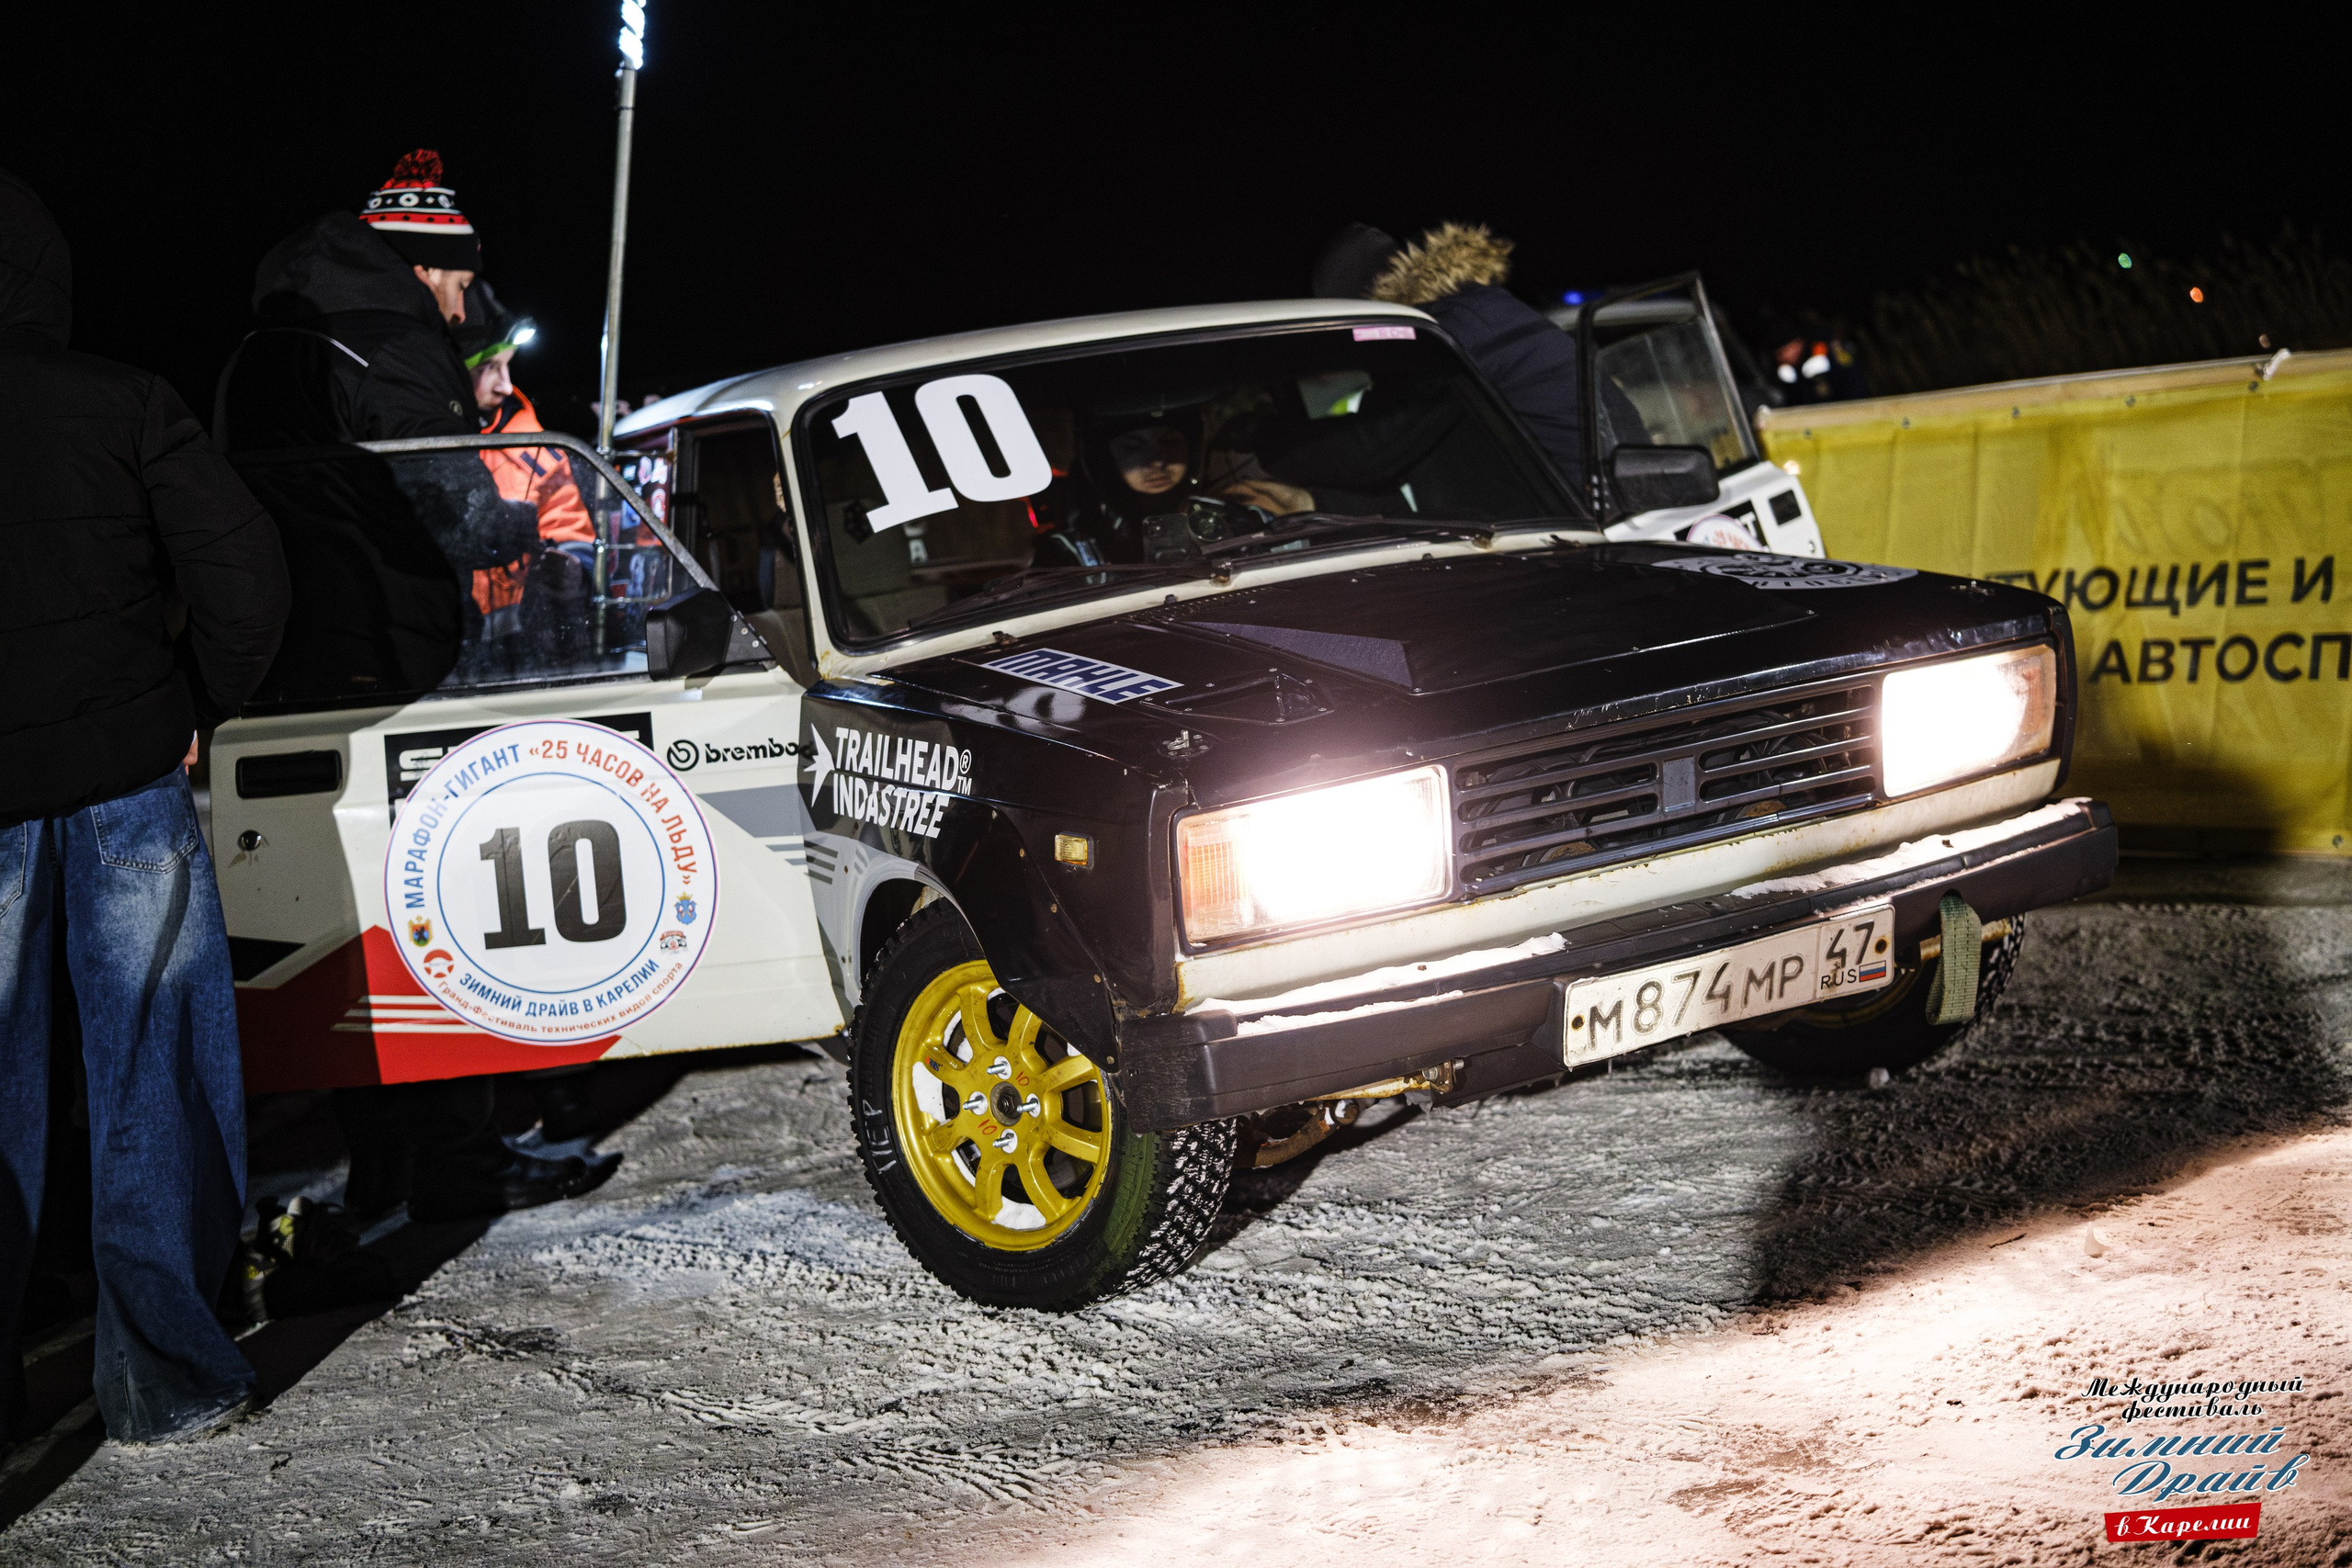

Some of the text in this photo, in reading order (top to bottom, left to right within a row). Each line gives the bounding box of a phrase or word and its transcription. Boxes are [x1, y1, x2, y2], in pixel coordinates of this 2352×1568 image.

[831, 373, 1053, 534] 10
[2291, 555, 2335, 604] И
[989, 649, 1173, 702] MAHLE
[2086, 632, 2352, 684] АВТОСП
[705, 738, 799, 763] brembo
[404, 743, 520, 909] МАРАФОН-ГИГАНТ
[576, 742, 644, 787] ЧАСОВ
[640, 783, 670, 814] НА
[833, 773, 950, 839] INDASTREE
[479, 819, 628, 950] 10
[1826, 919, 1876, 968] 47
[438, 962, 683, 1033] Гранд-Фестиваль технических видов спорта
[459, 958, 660, 1017] ЗИМНИЙ ДРАЙВ В КАРЕЛИИ
[1820, 968, 1857, 989] RUS
[1015, 1071, 1030, 1086] 10
[978, 1119, 998, 1135] 10
